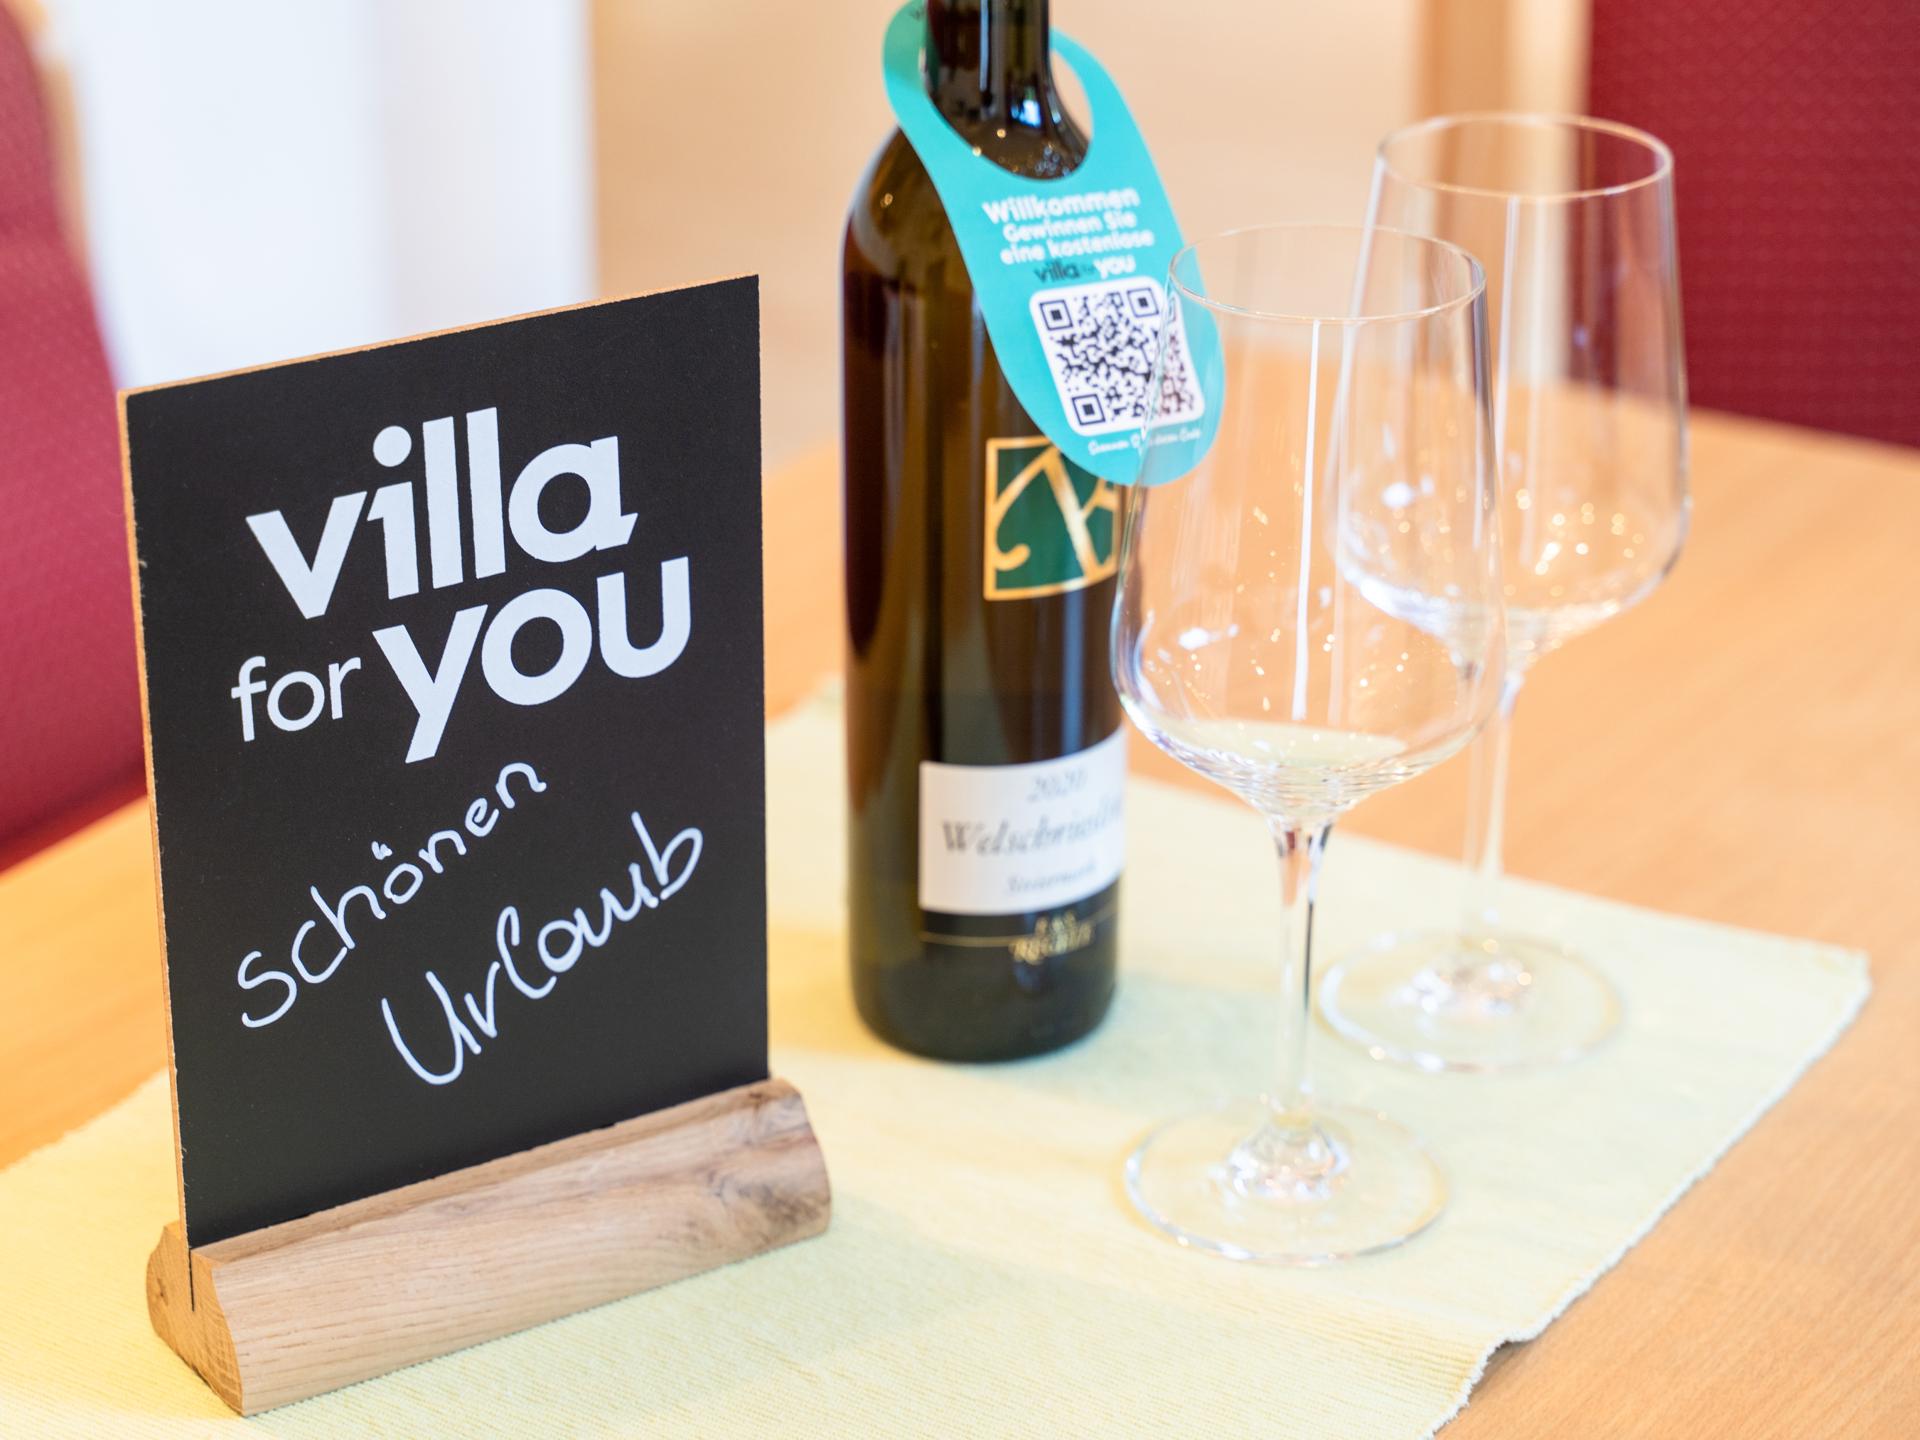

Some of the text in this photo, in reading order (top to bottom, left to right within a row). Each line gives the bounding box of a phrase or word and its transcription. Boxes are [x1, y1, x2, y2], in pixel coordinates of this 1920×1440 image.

[981, 187, 1140, 224] Willkommen
[1002, 209, 1137, 243] Gewinnen Sie
[1000, 229, 1154, 265] eine kostenlose
[1034, 258, 1081, 284] villa
[246, 407, 639, 619] villa
[231, 656, 361, 742] for
[382, 812, 703, 1085] Urlaub
